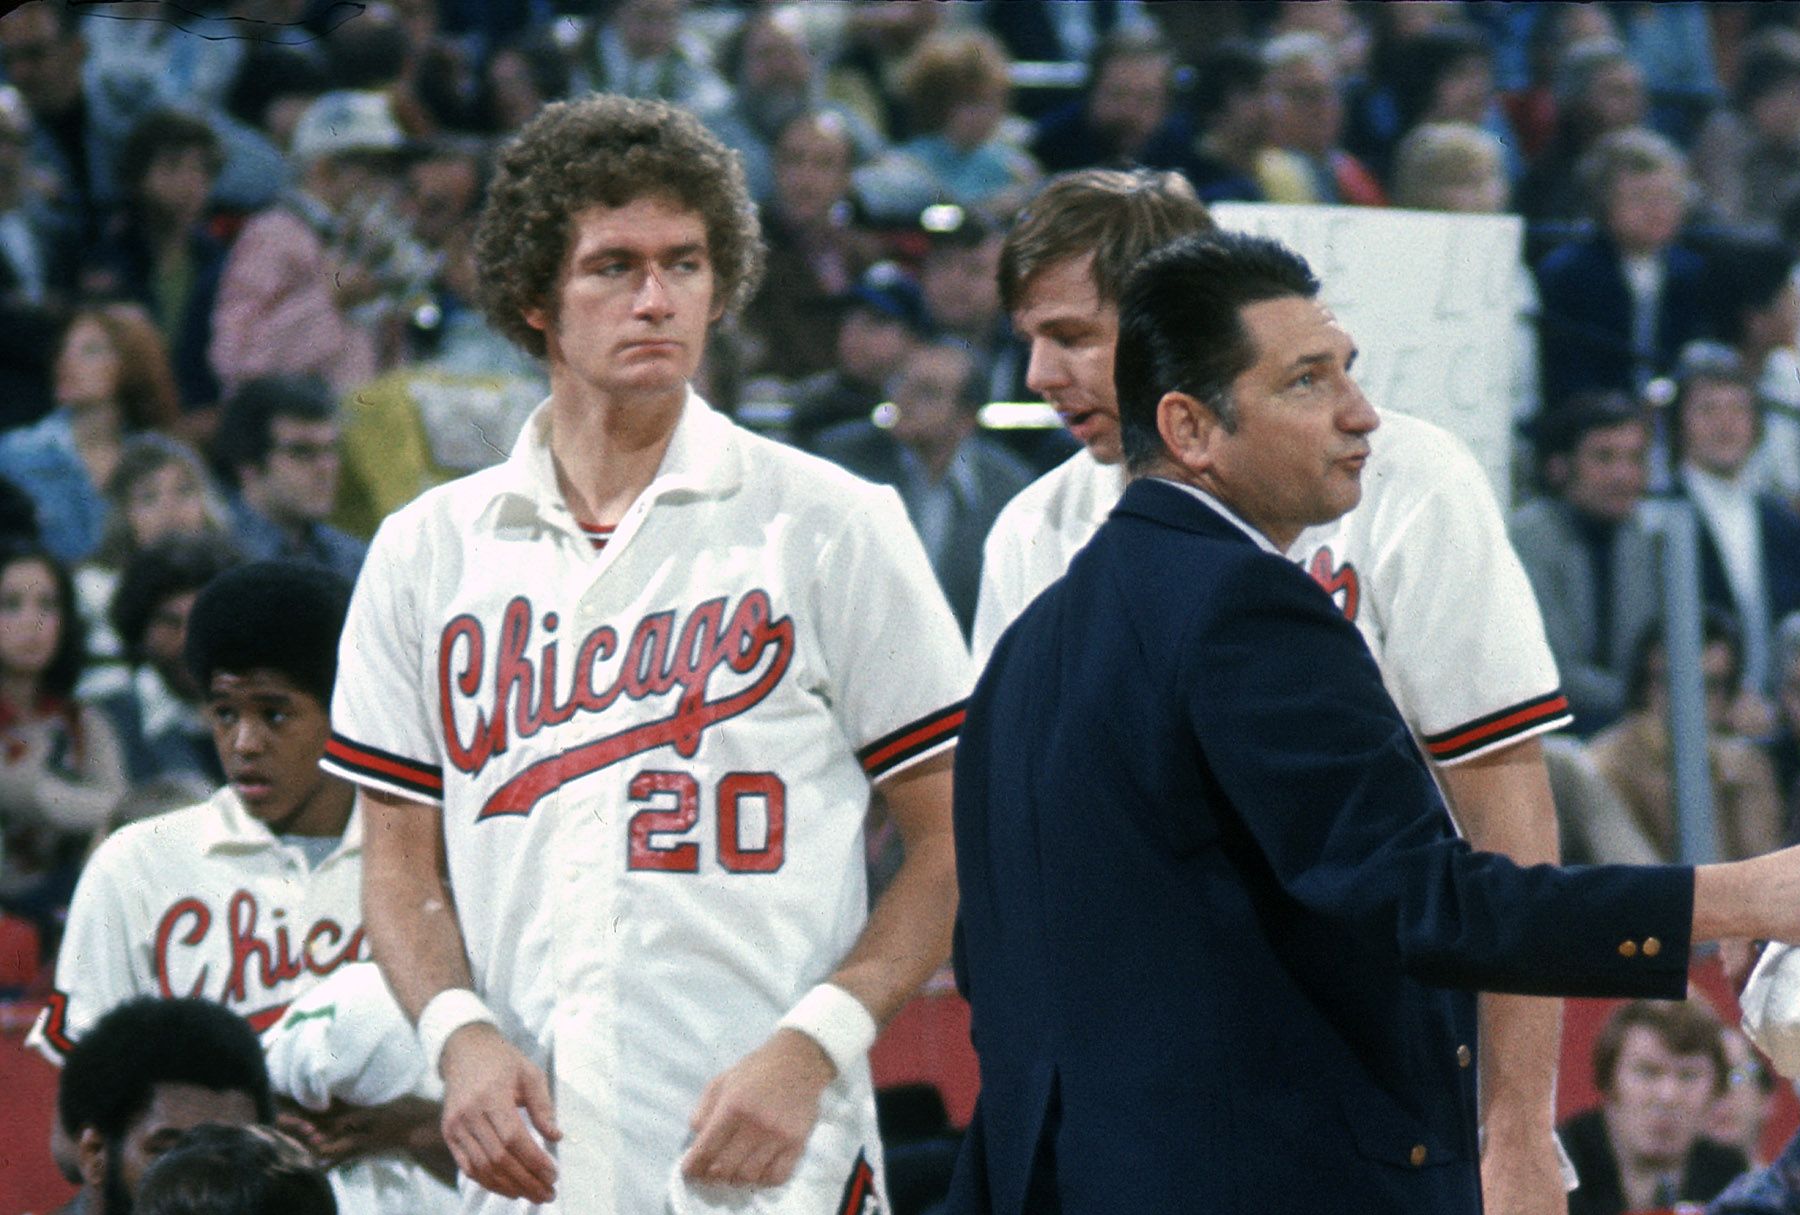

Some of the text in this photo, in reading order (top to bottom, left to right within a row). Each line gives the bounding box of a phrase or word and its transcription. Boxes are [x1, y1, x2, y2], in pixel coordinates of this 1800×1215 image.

[438, 588, 795, 780] Chicago
[626, 769, 787, 874] 20
[154, 887, 367, 1006] Chic
